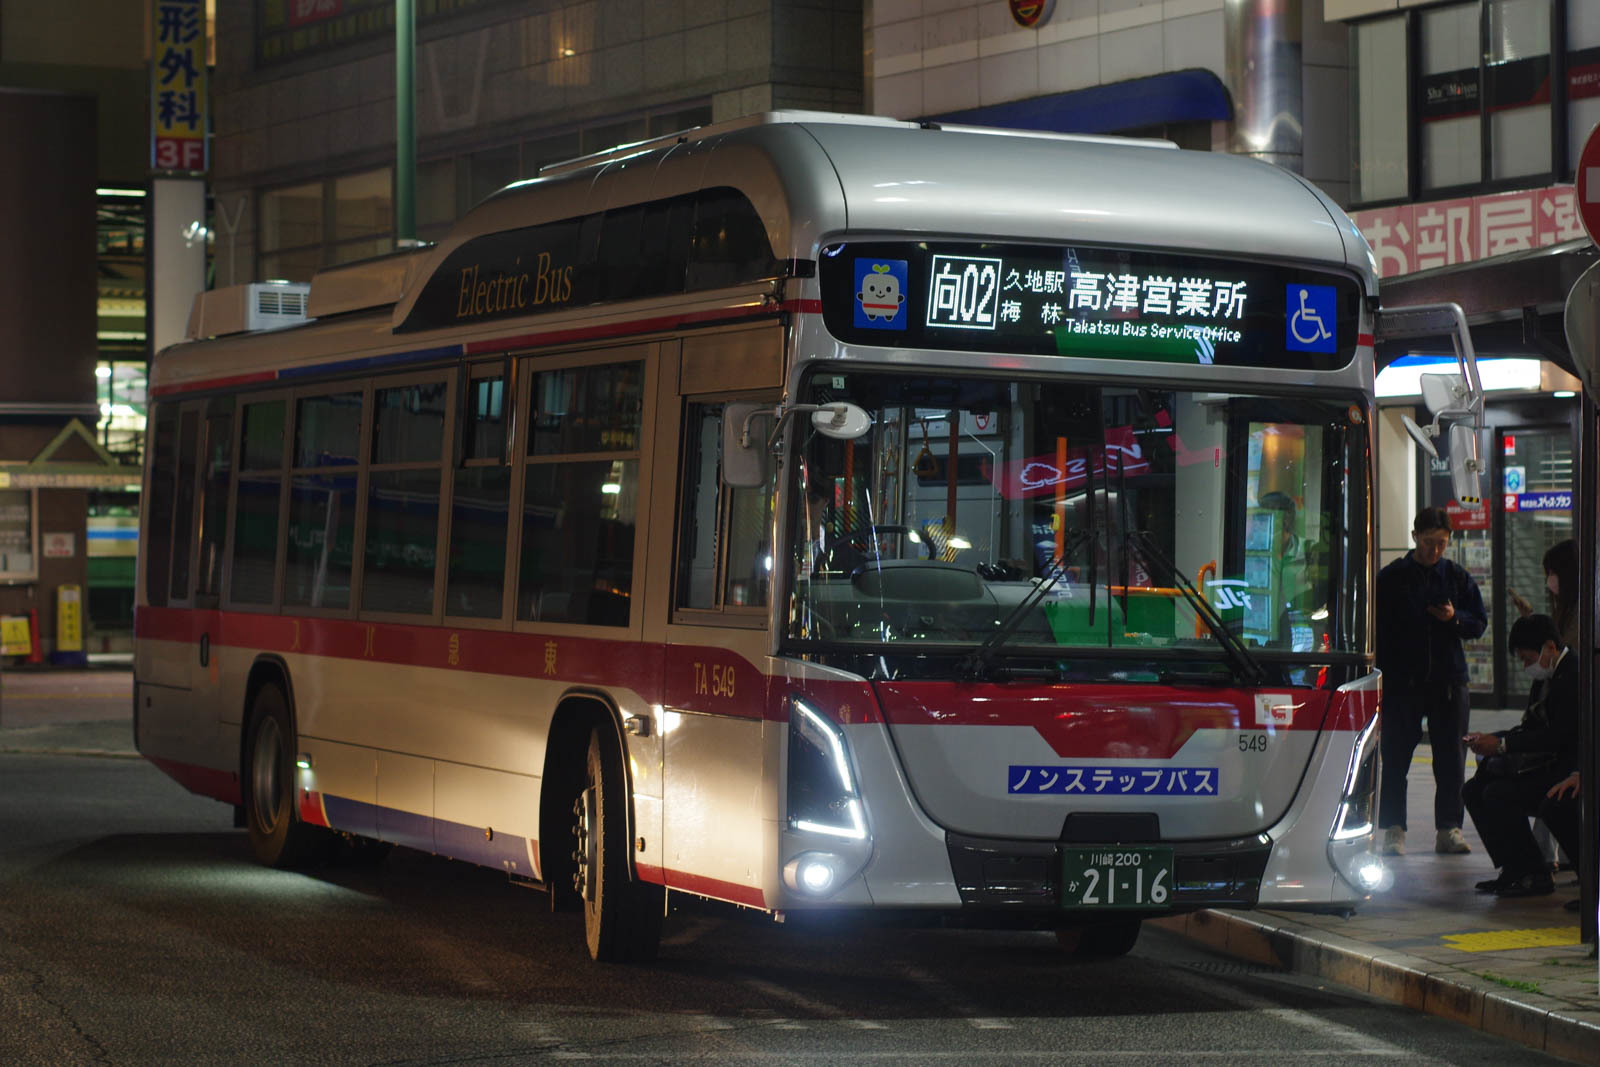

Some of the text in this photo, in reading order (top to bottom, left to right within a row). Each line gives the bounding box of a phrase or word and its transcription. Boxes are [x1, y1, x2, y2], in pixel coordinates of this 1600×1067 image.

[159, 0, 200, 130] 形外科
[157, 140, 202, 169] 3F
[456, 252, 574, 318] Electric Bus
[932, 262, 996, 322] 向02
[1003, 268, 1065, 294] 久地駅
[1068, 271, 1247, 319] 高津営業所
[1066, 318, 1242, 342] Takatsu Bus Service Office
[694, 662, 736, 698] TA 549
[1239, 734, 1268, 752] 549
[1012, 768, 1214, 793] ノンステップバス
[1068, 868, 1168, 904] か 21-16
